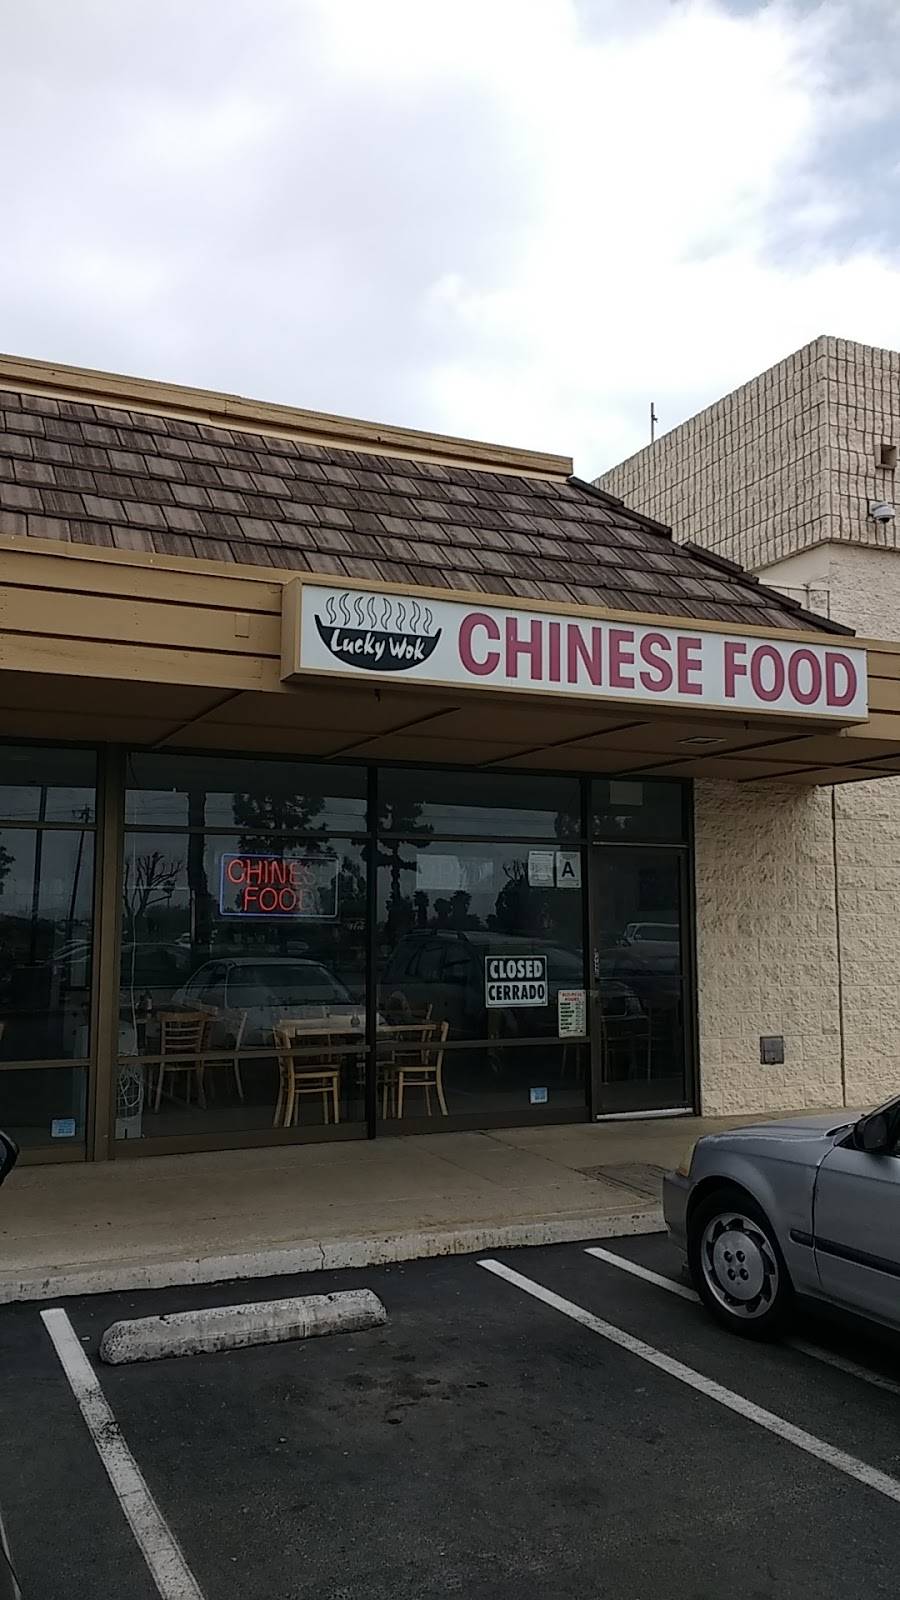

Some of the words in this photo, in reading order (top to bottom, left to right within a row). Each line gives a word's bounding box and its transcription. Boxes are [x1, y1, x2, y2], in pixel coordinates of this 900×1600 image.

[330, 629, 386, 662] Lucky
[389, 636, 426, 661] Wok
[458, 612, 703, 696] CHINESE
[723, 641, 858, 707] FOOD
[227, 859, 329, 885] CHINES
[561, 861, 575, 877] A
[244, 886, 315, 911] FOOD
[489, 960, 543, 979] CLOSED
[488, 984, 545, 1001] CERRADO
